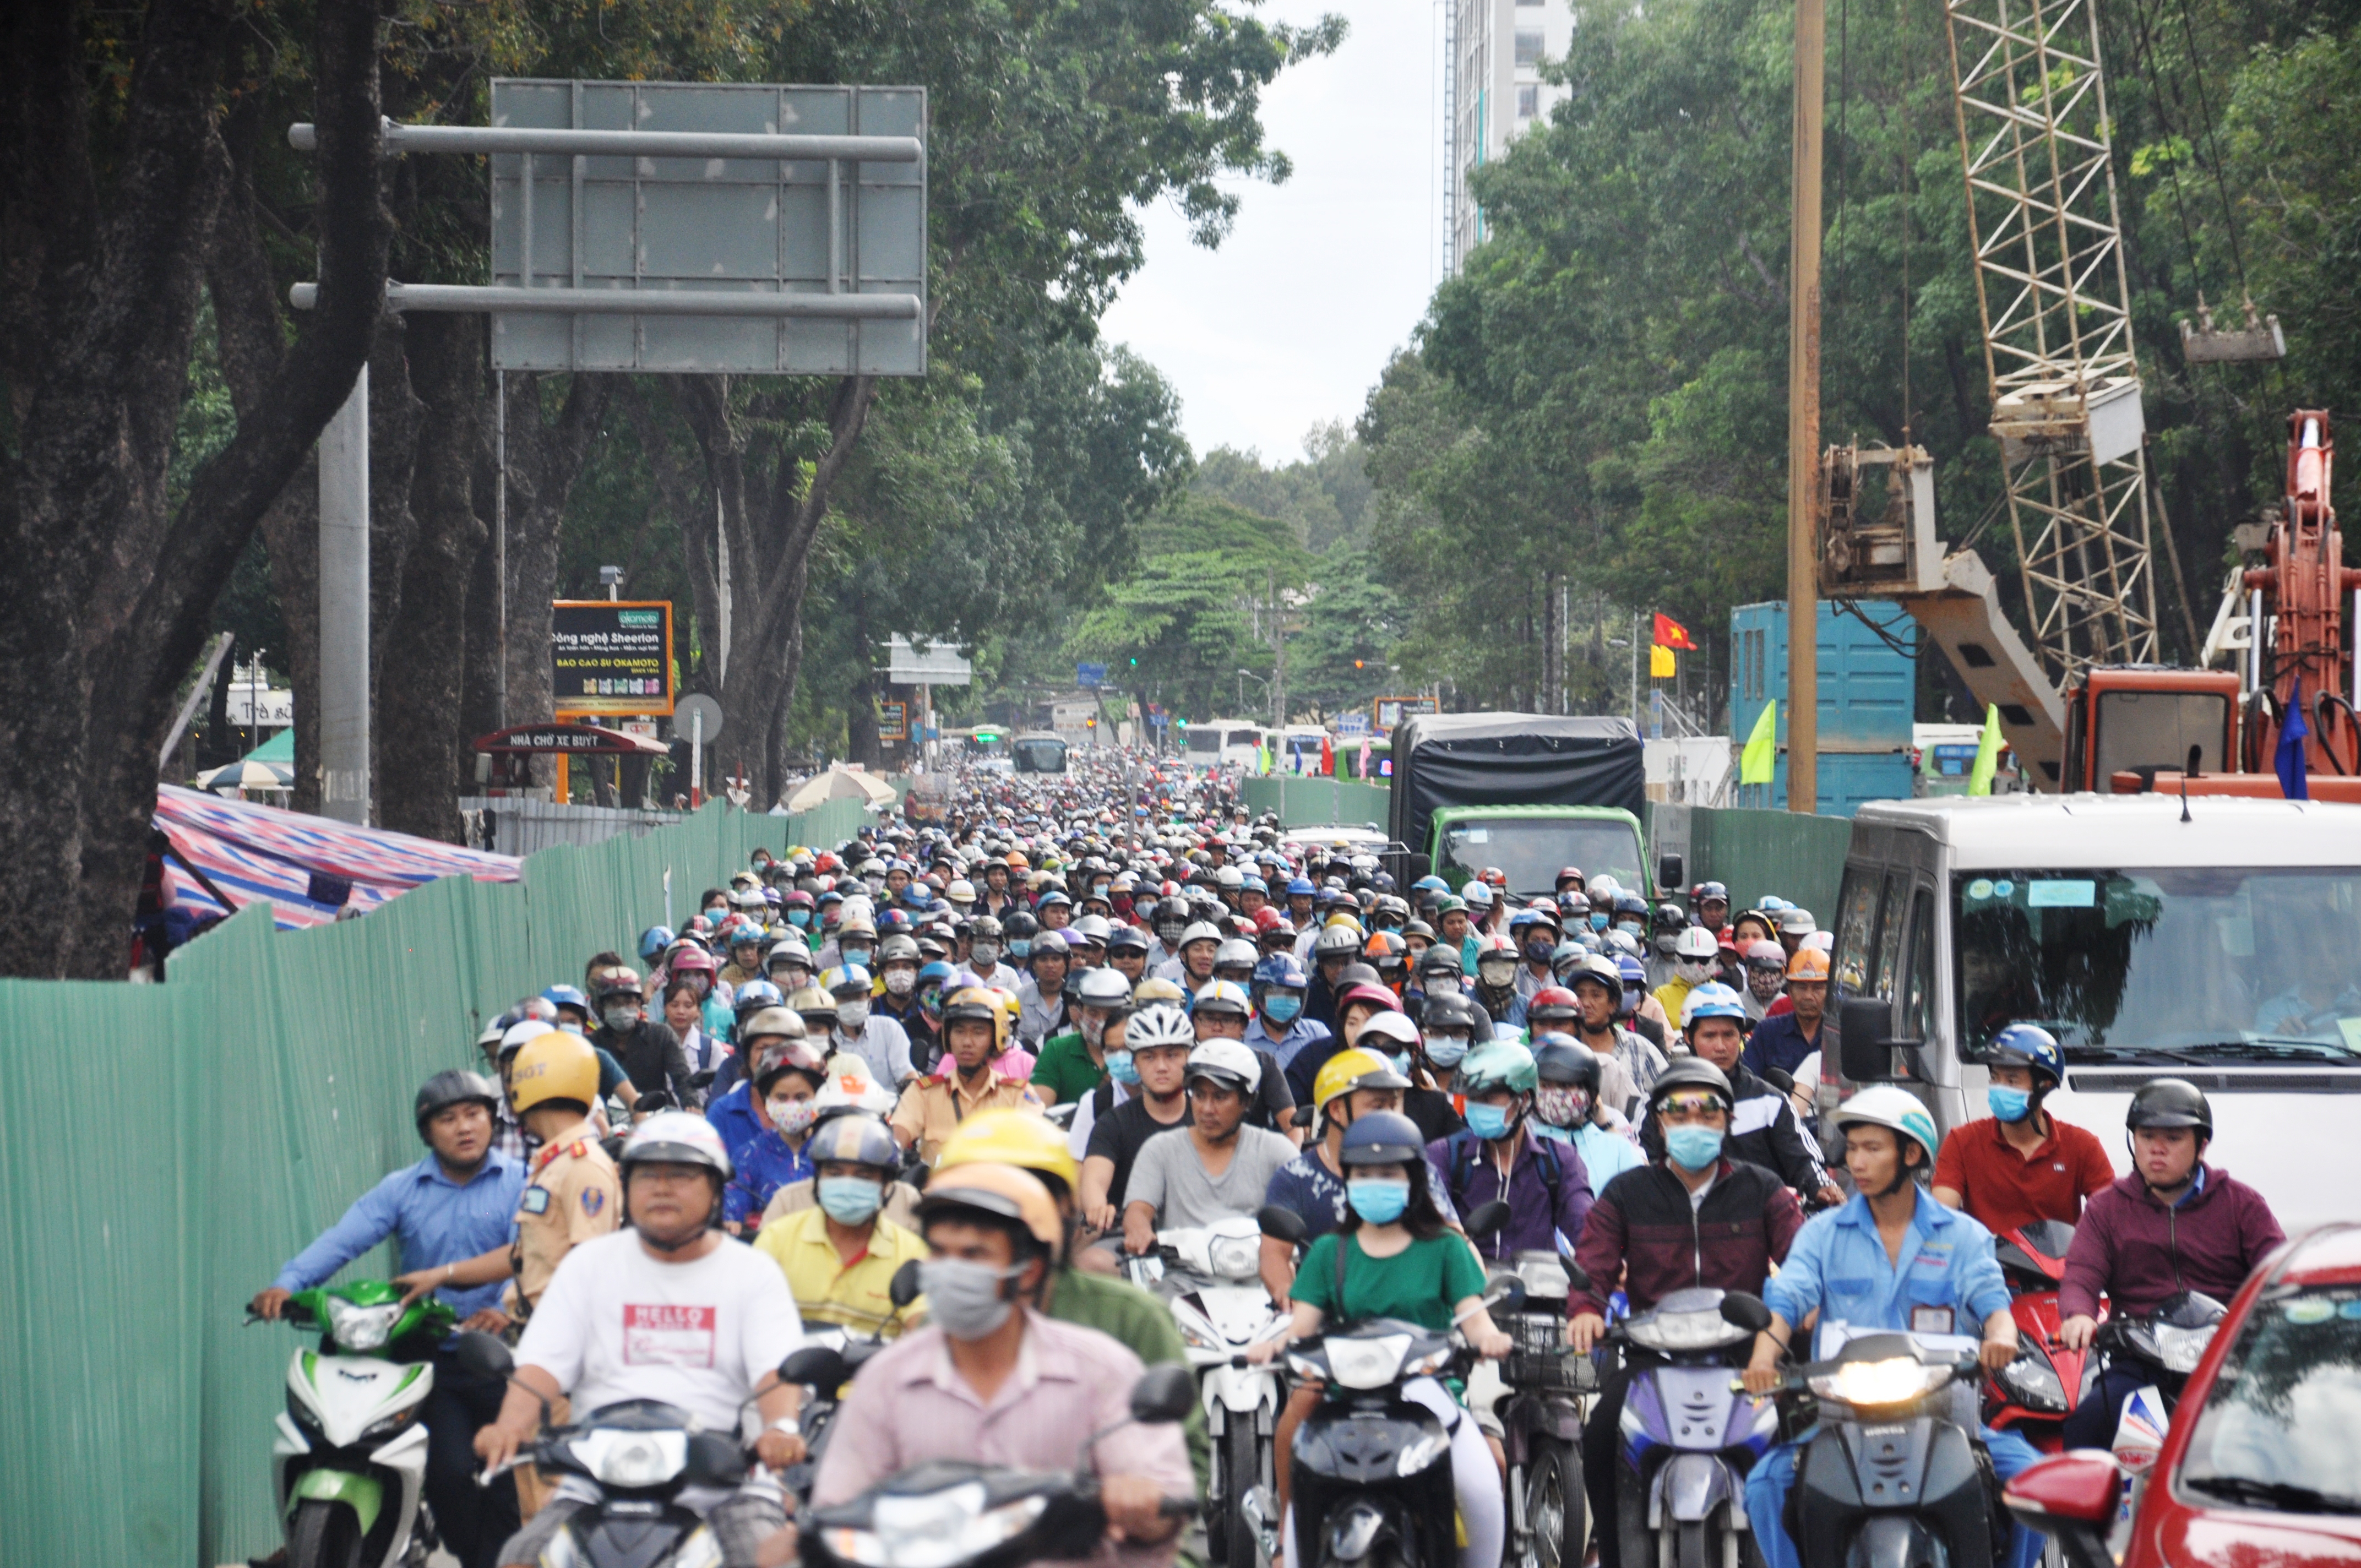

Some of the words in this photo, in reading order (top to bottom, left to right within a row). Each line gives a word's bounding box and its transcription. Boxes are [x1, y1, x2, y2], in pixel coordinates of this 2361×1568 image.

[580, 632, 608, 645] nghệ
[611, 633, 659, 643] Sheerlon
[557, 658, 576, 667] BAO
[578, 658, 599, 667] CAO
[600, 658, 612, 667] SU
[613, 658, 659, 668] OKAMOTO
[510, 732, 531, 746] NHÀ
[533, 732, 554, 747] CHỜ
[556, 734, 569, 747] XE
[572, 732, 599, 747] BUÝT
[635, 1306, 703, 1322] HELLO
